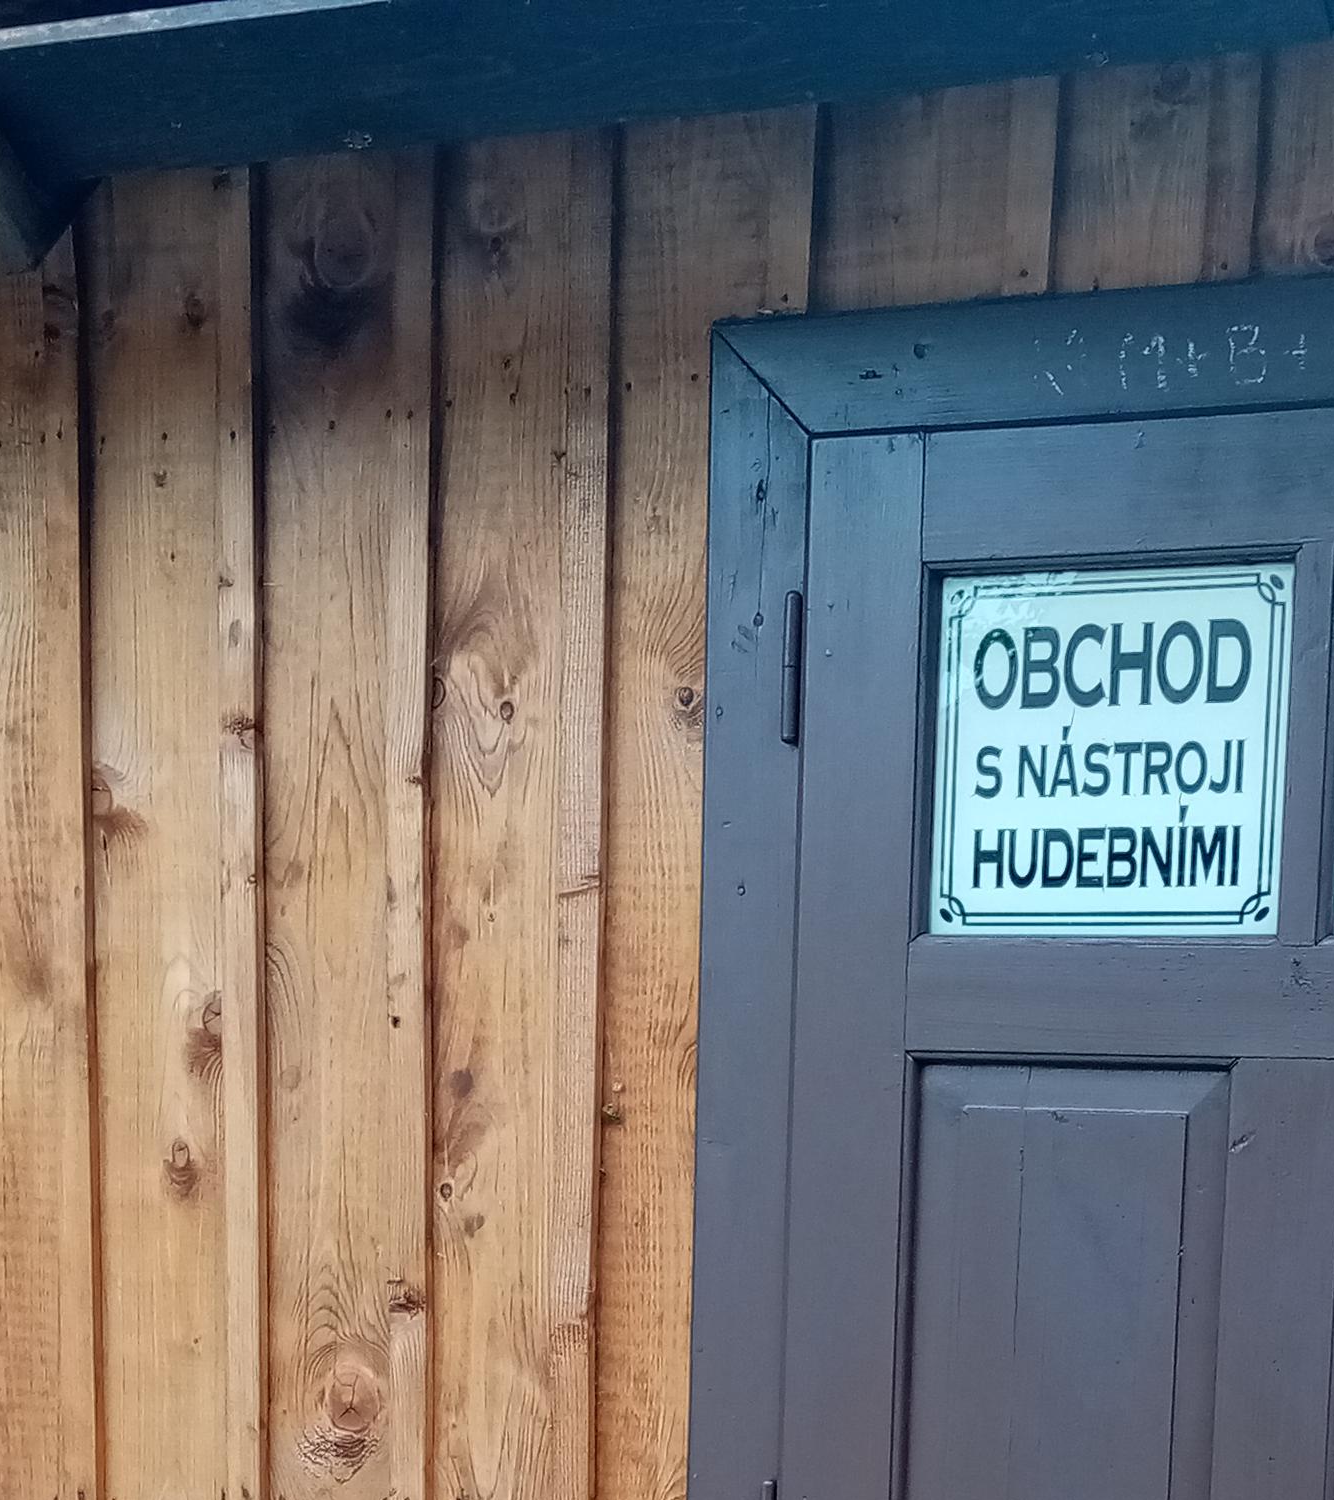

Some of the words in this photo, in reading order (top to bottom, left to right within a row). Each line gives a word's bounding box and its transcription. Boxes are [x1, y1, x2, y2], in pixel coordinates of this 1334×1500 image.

[973, 618, 1253, 710] OBCHOD
[972, 745, 1003, 799] S
[1016, 726, 1246, 798] NÁSTROJI
[971, 804, 1242, 889] HUDEBNÍMI
